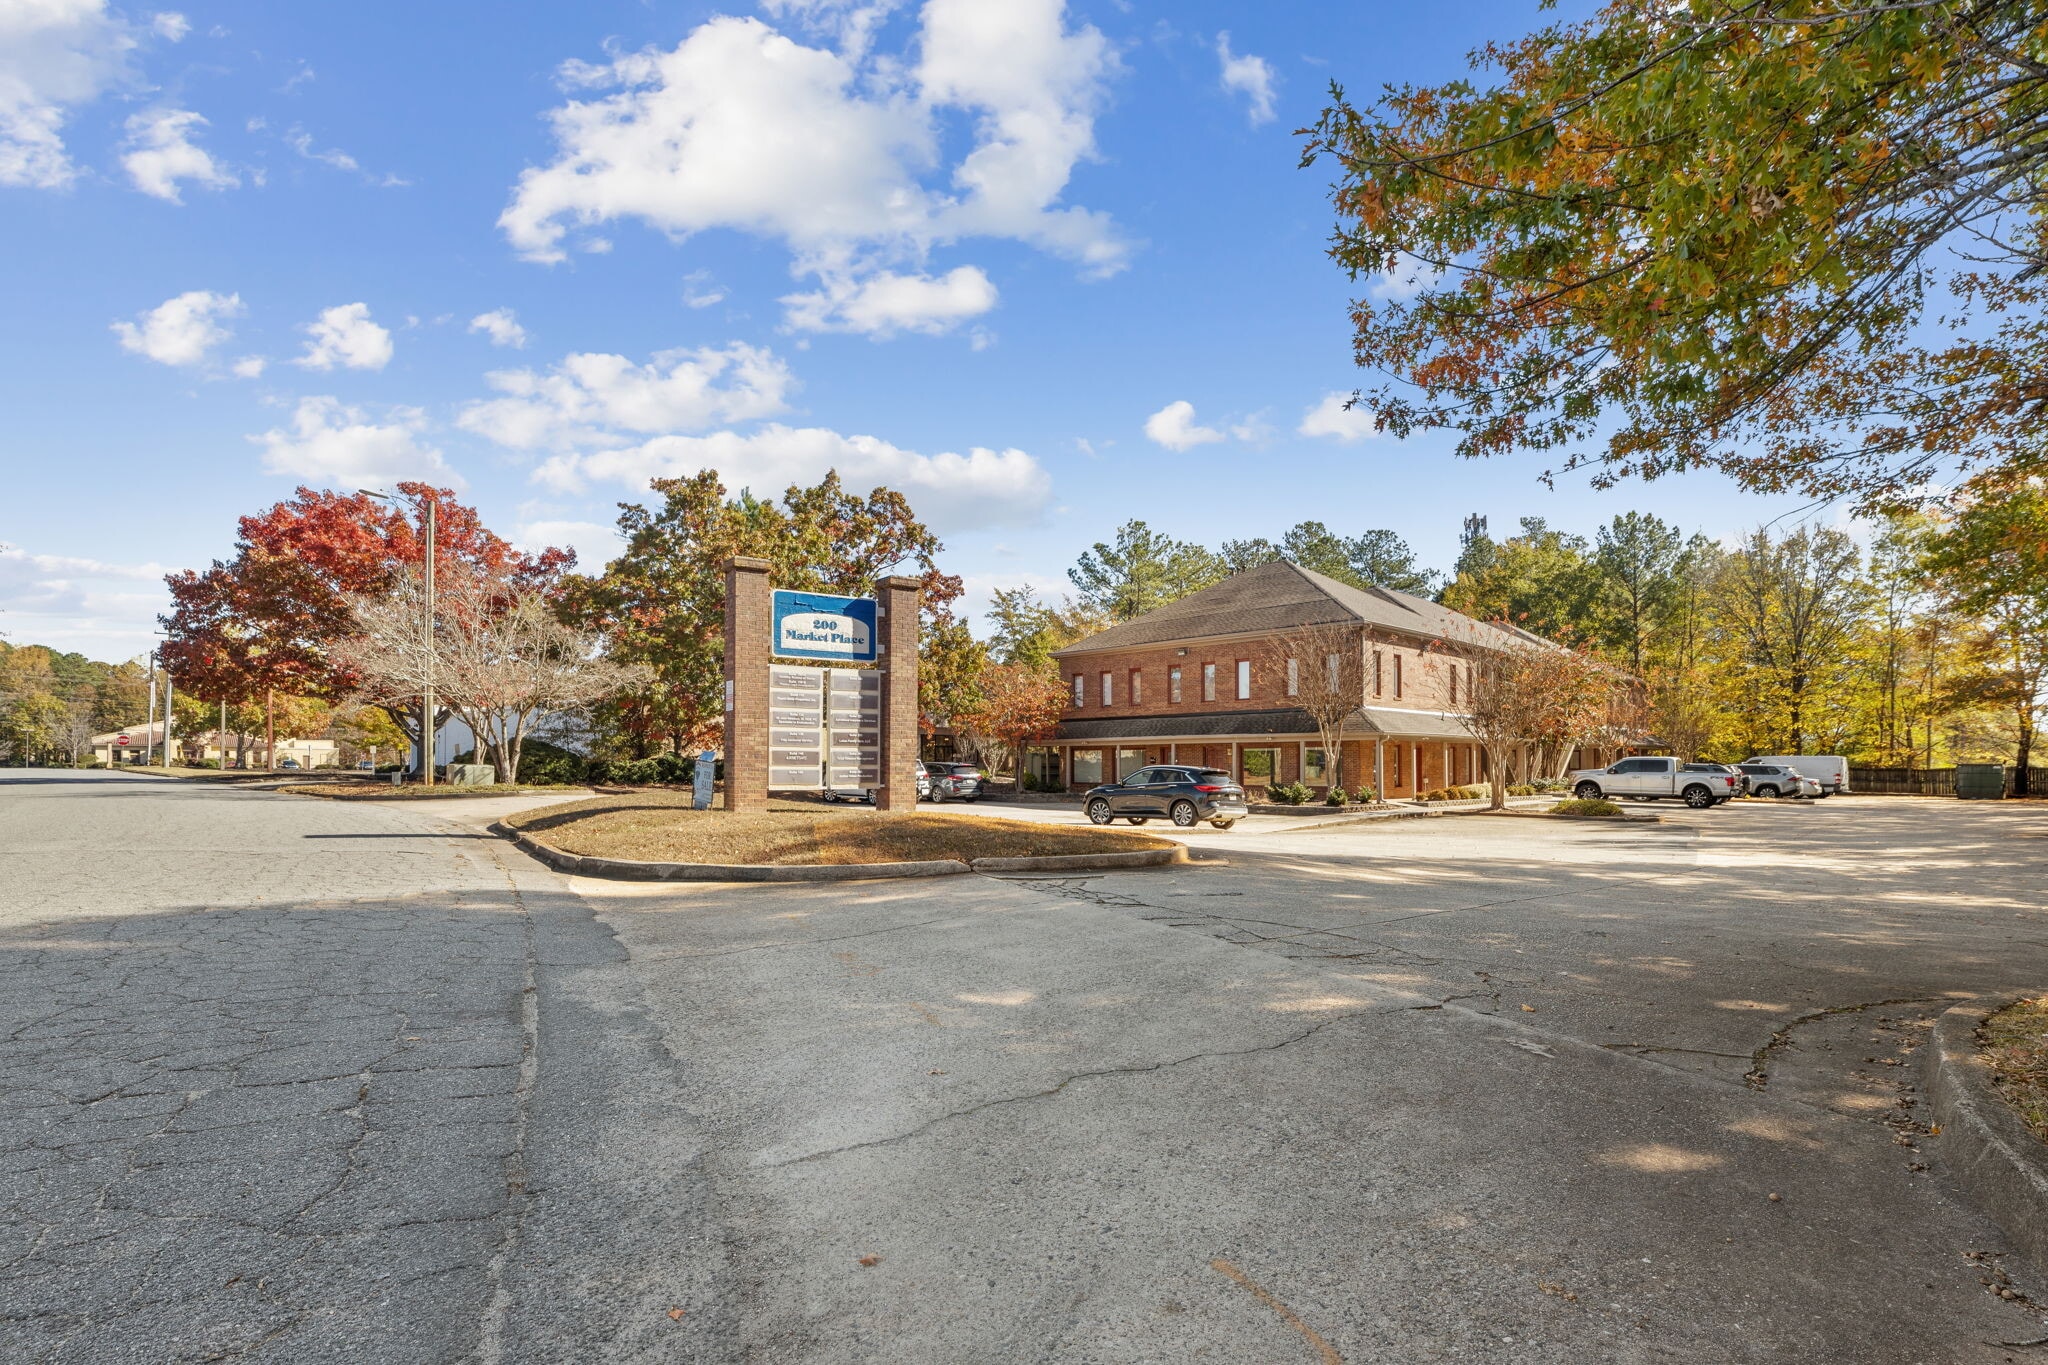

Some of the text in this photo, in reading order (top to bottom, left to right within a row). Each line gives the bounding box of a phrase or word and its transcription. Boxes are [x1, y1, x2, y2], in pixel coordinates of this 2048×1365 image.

[813, 619, 837, 631] 200
[785, 629, 865, 644] Market Place
[701, 780, 712, 791] SALE
